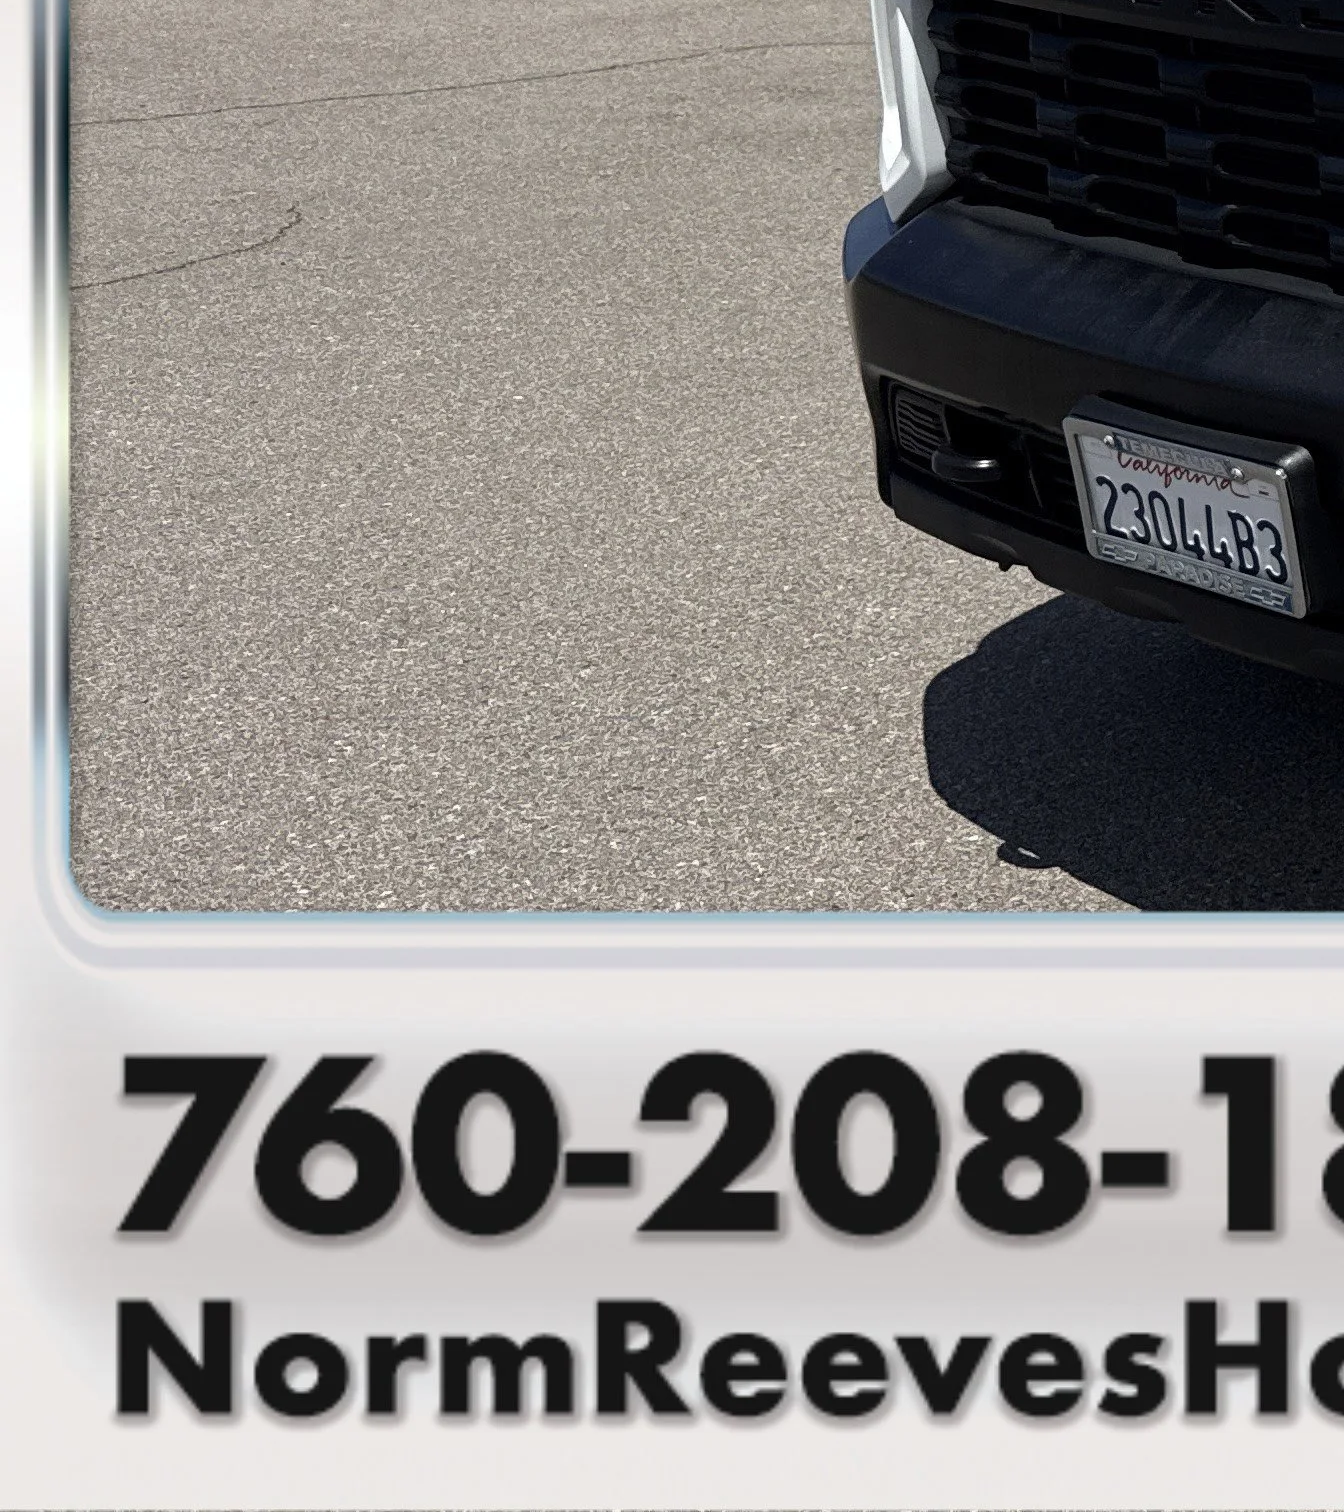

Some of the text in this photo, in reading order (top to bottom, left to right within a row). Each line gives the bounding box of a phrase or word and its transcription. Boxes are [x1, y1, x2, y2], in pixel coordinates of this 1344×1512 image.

[1116, 449, 1250, 499] California
[1095, 475, 1288, 584] 23044B3
[1144, 553, 1246, 598] PARADISE
